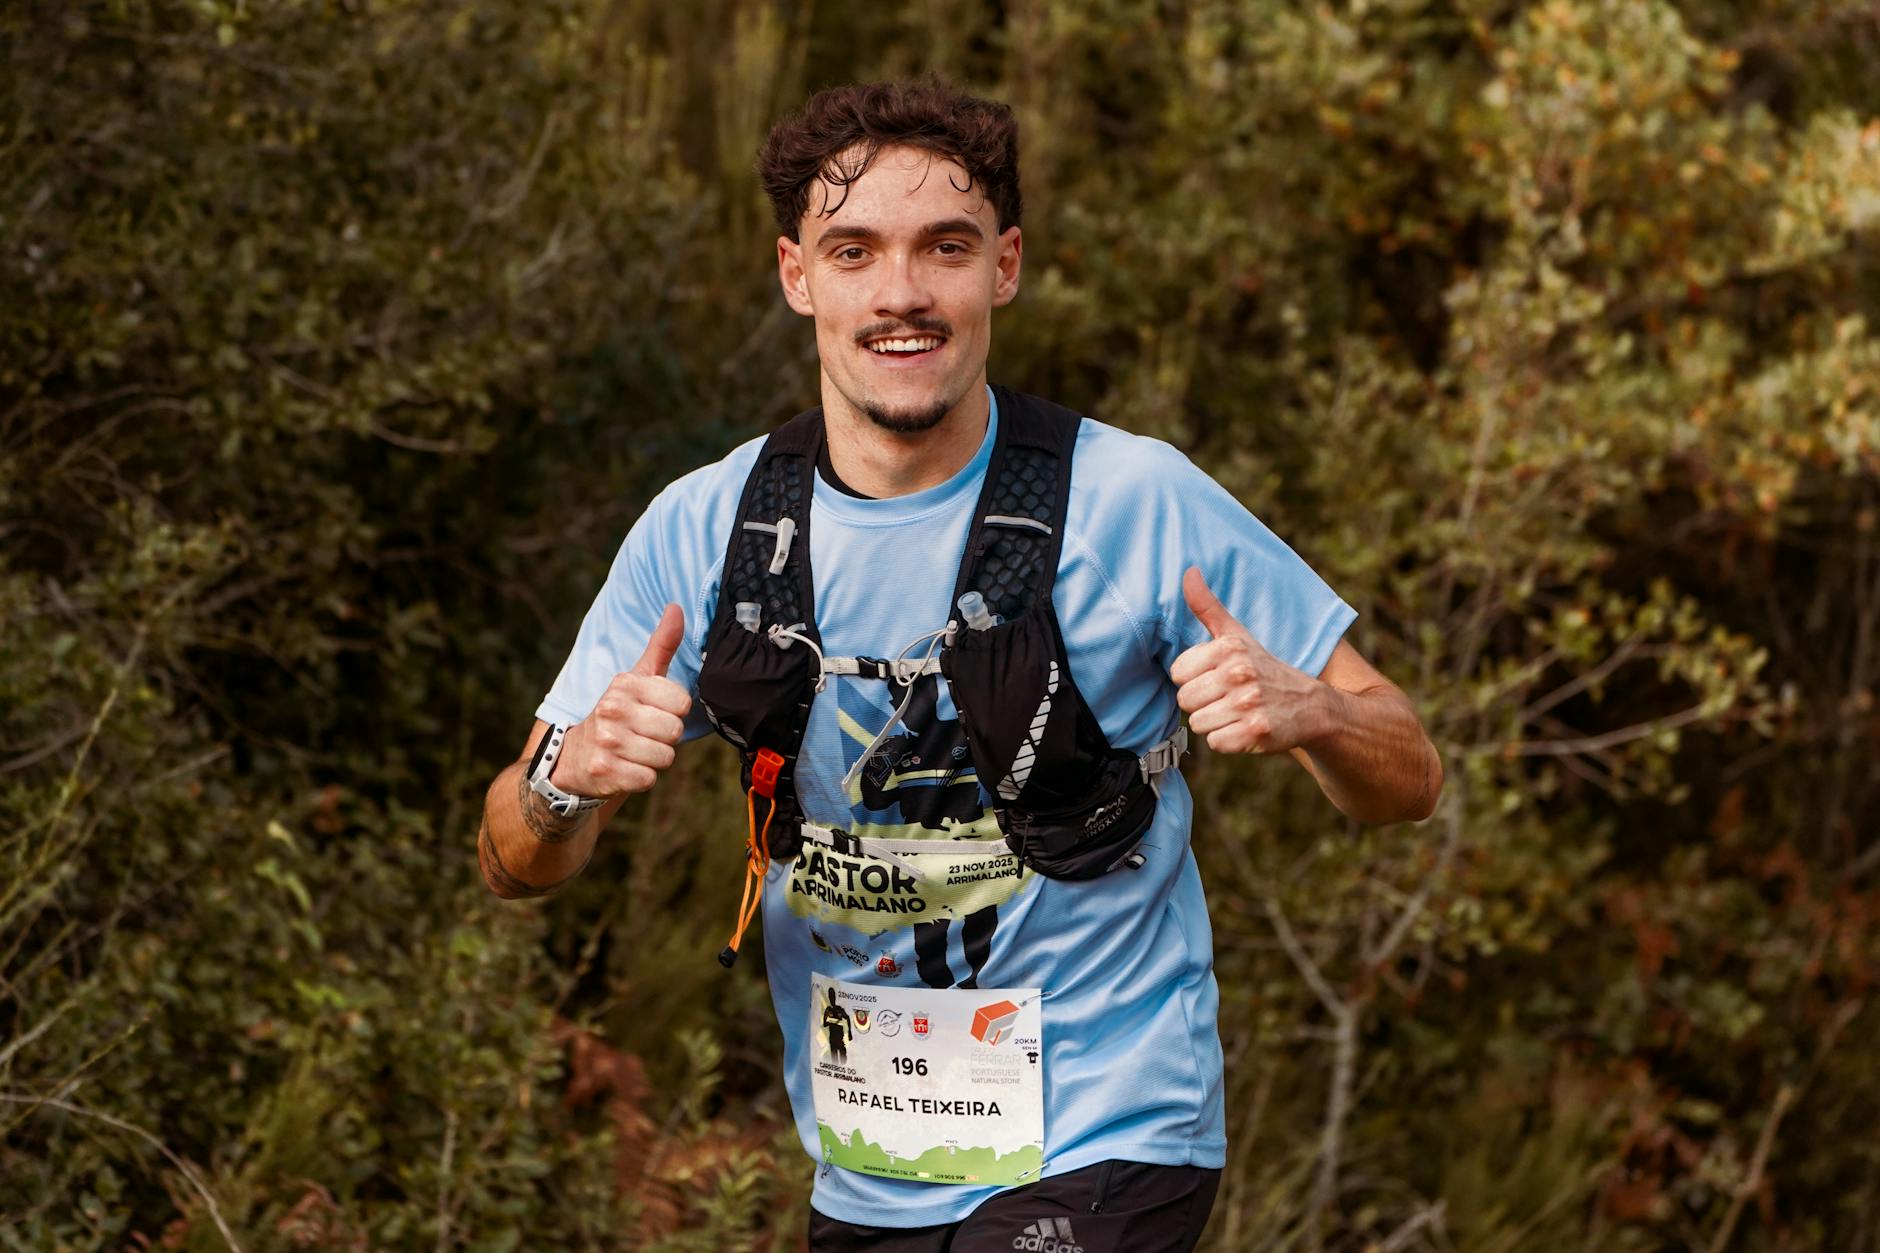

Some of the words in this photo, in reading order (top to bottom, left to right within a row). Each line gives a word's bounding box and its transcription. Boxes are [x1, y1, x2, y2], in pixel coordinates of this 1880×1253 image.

[949, 865, 960, 874] 23
[963, 862, 986, 873] NOV
[988, 857, 1013, 869] 2025
[946, 868, 1018, 886] ARRIMALANO
[792, 878, 926, 914] ARRIMALANO
[892, 1056, 928, 1077] 196
[971, 1068, 1021, 1077] PORTUGUESE
[971, 1077, 999, 1085] NATURAL
[1000, 1077, 1021, 1085] STONE
[838, 1088, 904, 1112] RAFAEL
[908, 1098, 1002, 1117] TEIXEIRA
[1012, 1234, 1084, 1253] adidas
